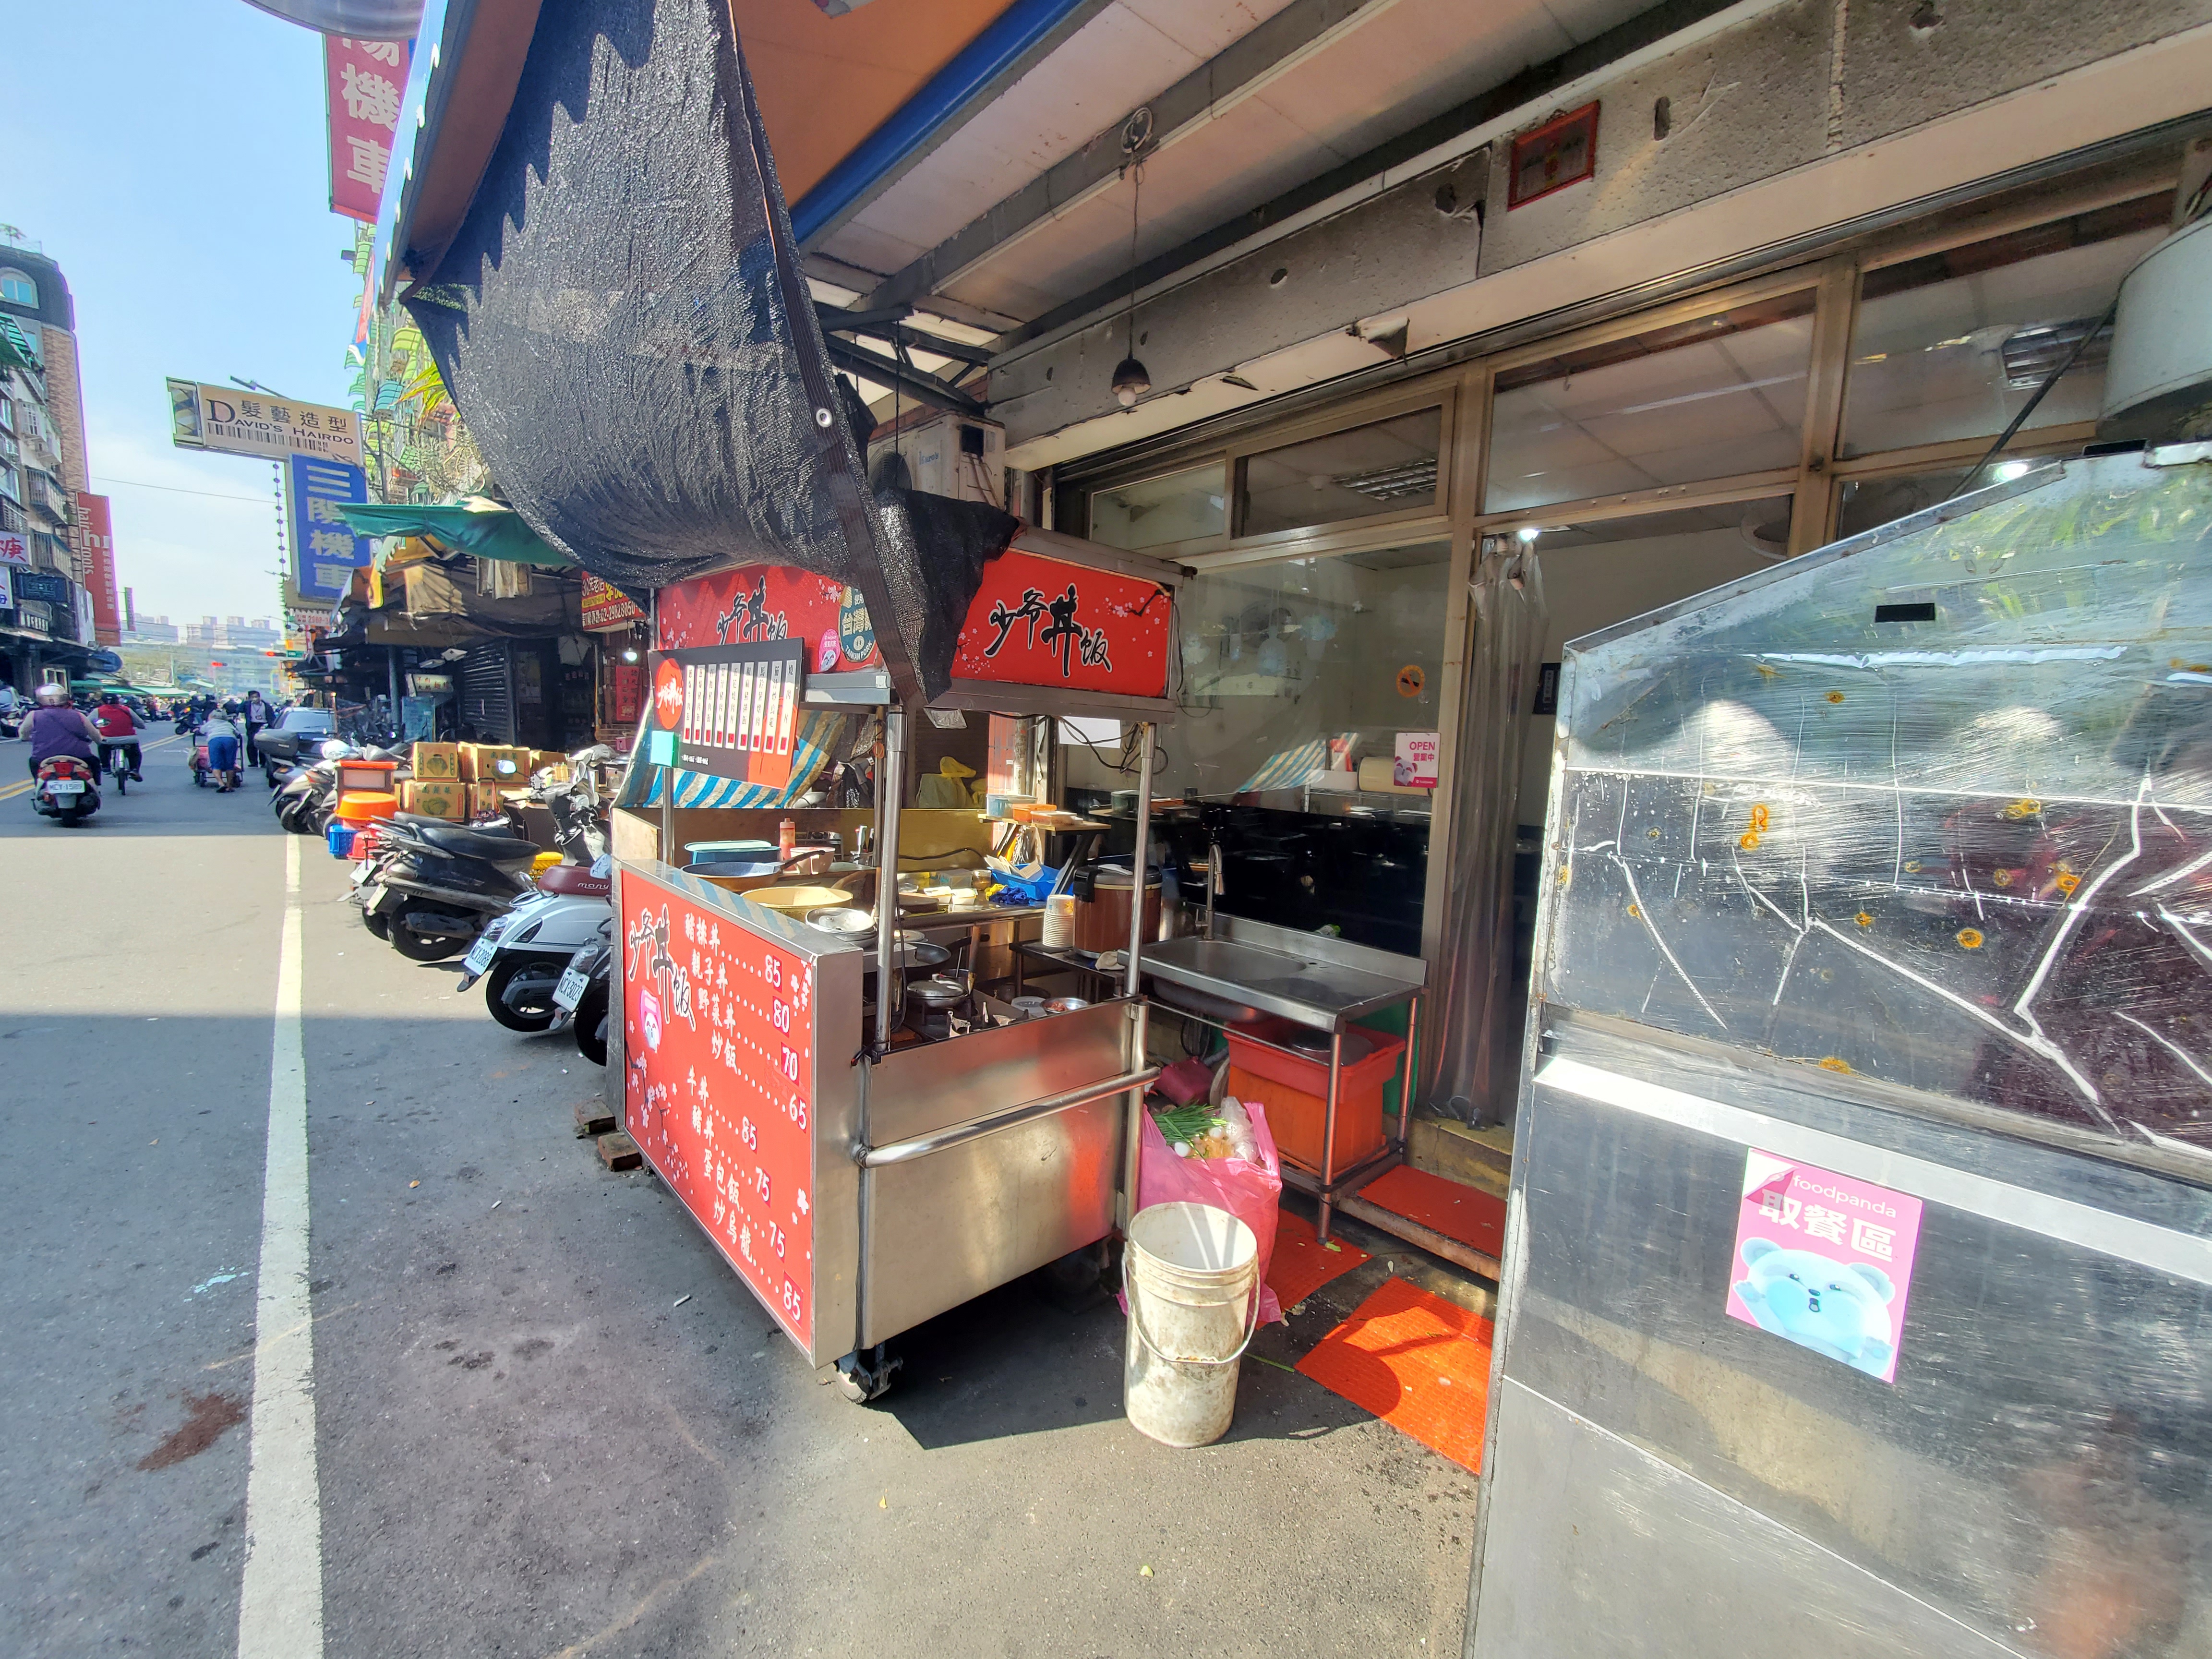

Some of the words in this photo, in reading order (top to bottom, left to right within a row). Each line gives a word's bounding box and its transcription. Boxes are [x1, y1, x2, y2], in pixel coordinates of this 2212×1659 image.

[205, 399, 283, 433] DAVID'S
[293, 427, 354, 444] HAIRDO
[241, 400, 348, 433] 髮藝造型
[845, 645, 861, 660] TAIWAN
[860, 639, 873, 659] PORK
[1409, 741, 1435, 750] OPEN
[557, 976, 583, 1002] NCX-3023
[765, 954, 781, 988] 85
[773, 1000, 790, 1033] 80
[711, 1029, 737, 1074] 炒飯
[789, 1092, 807, 1130] 65
[782, 1046, 798, 1082] 70
[742, 1116, 757, 1151] 85
[756, 1166, 770, 1202] 75
[1792, 1175, 1897, 1218] foodpanda
[704, 1148, 740, 1212] 蛋包飯
[769, 1220, 785, 1258] 75
[1758, 1189, 1897, 1262] 取餐區
[714, 1196, 753, 1263] 炒烏龍
[783, 1281, 801, 1321] 85
